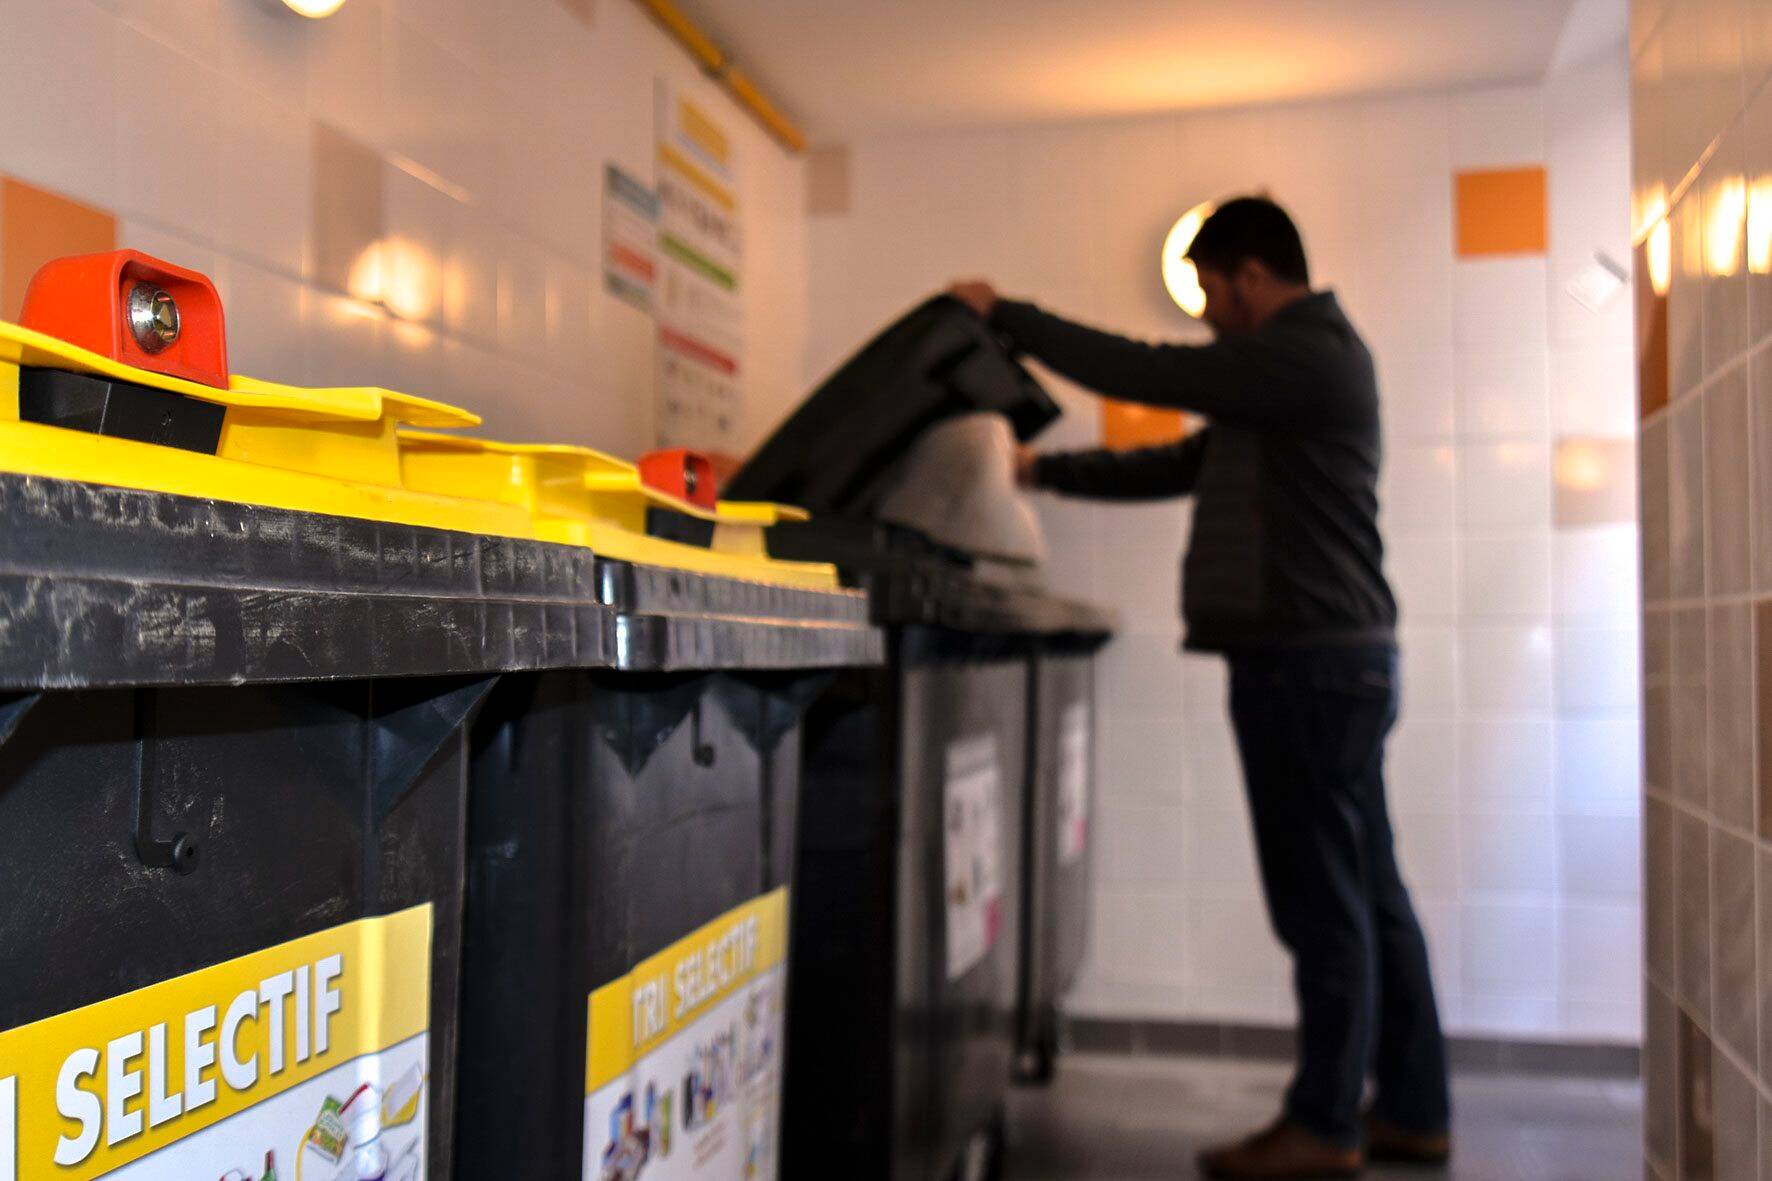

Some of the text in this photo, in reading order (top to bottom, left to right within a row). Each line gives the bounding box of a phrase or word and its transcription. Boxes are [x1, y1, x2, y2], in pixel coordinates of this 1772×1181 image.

[53, 953, 343, 1167] SELECTIF
[632, 914, 759, 1048] TRI SELECTIF
